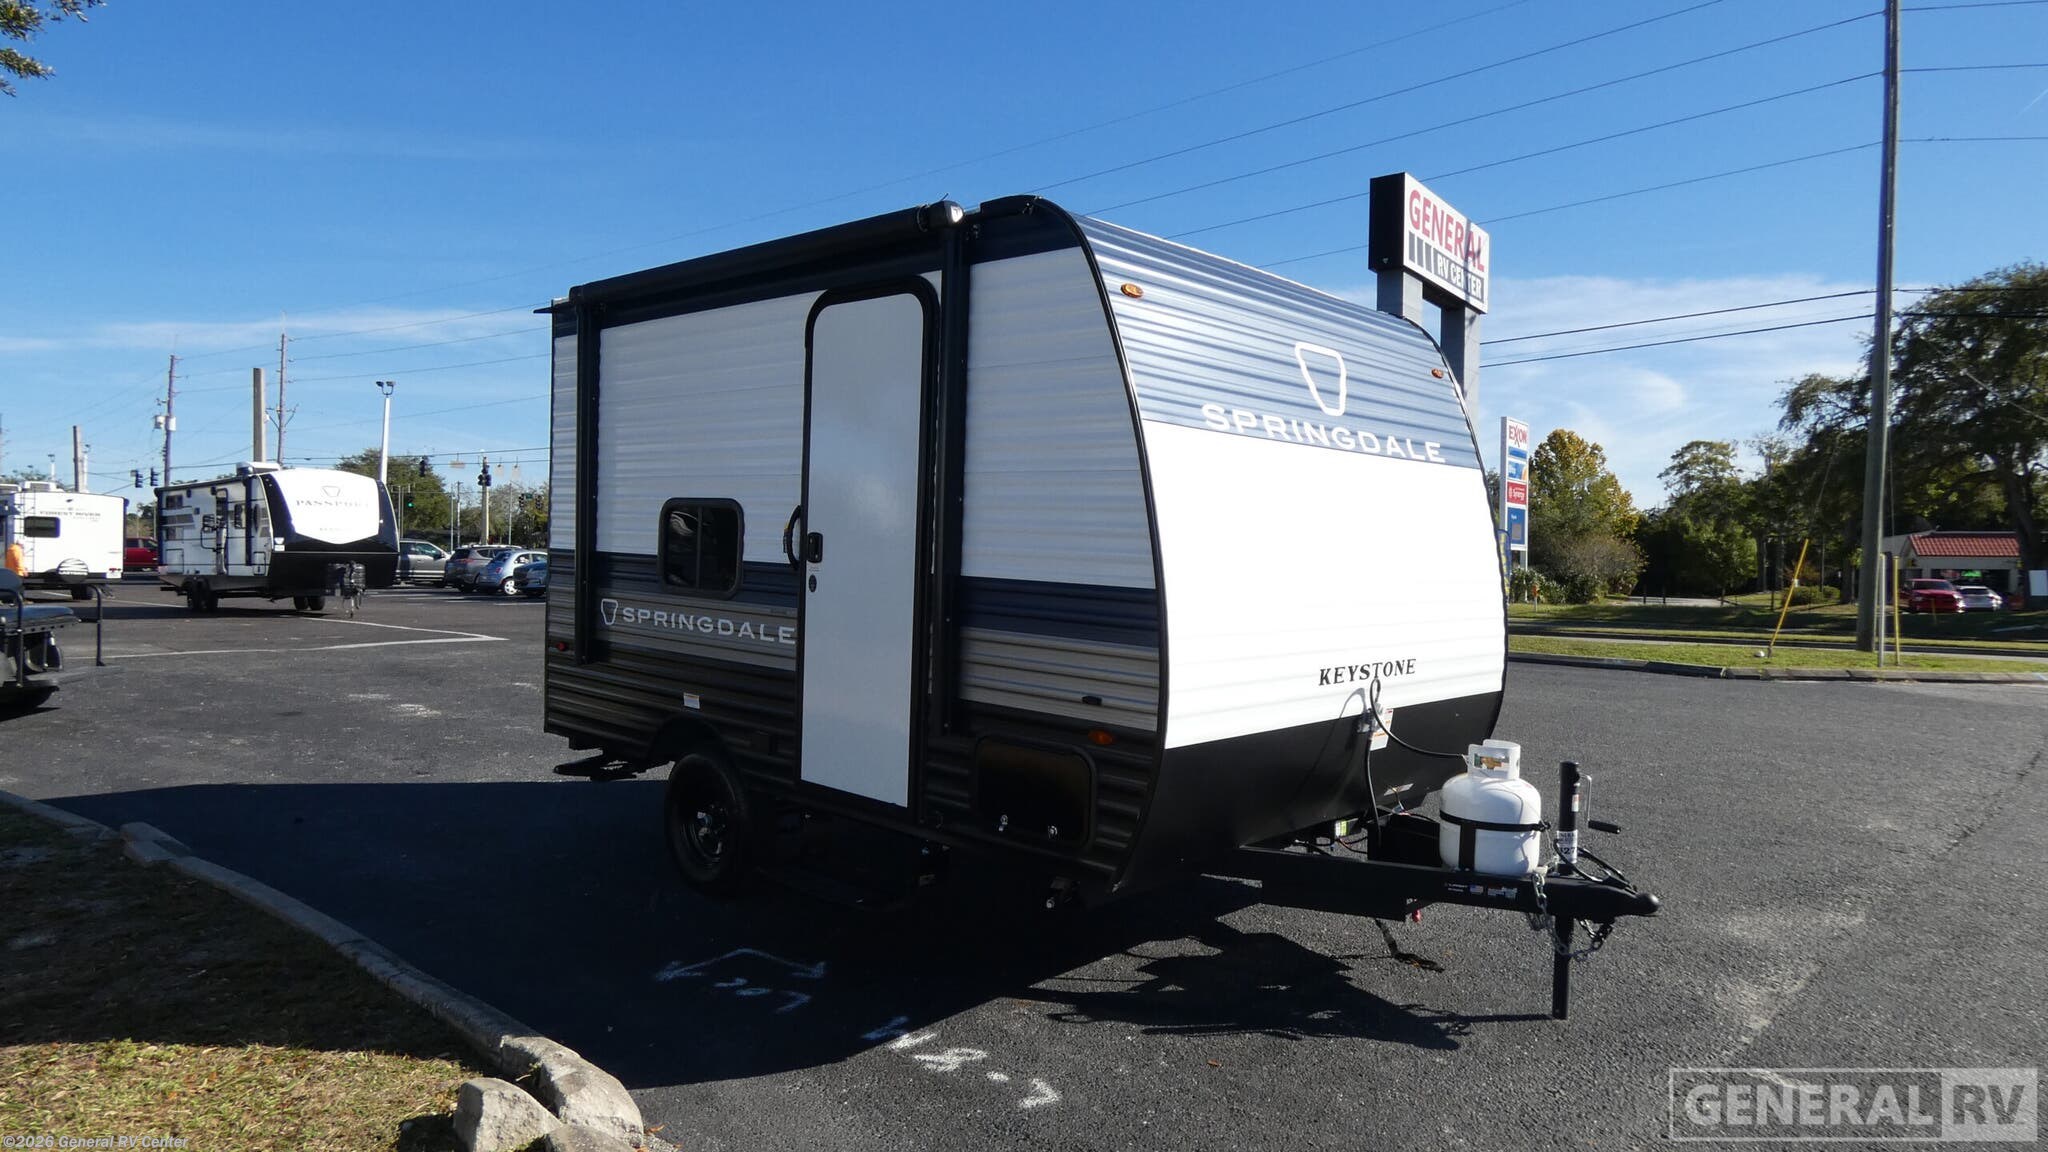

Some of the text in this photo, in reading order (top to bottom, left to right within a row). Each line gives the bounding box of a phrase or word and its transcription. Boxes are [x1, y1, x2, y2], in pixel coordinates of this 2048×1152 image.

[1409, 189, 1485, 272] GENERAL
[1437, 252, 1482, 299] RV CENTER
[1201, 404, 1445, 463] SPRINGDALE
[622, 606, 796, 645] SPRINGDALE
[1318, 658, 1417, 686] KEYSTONE
